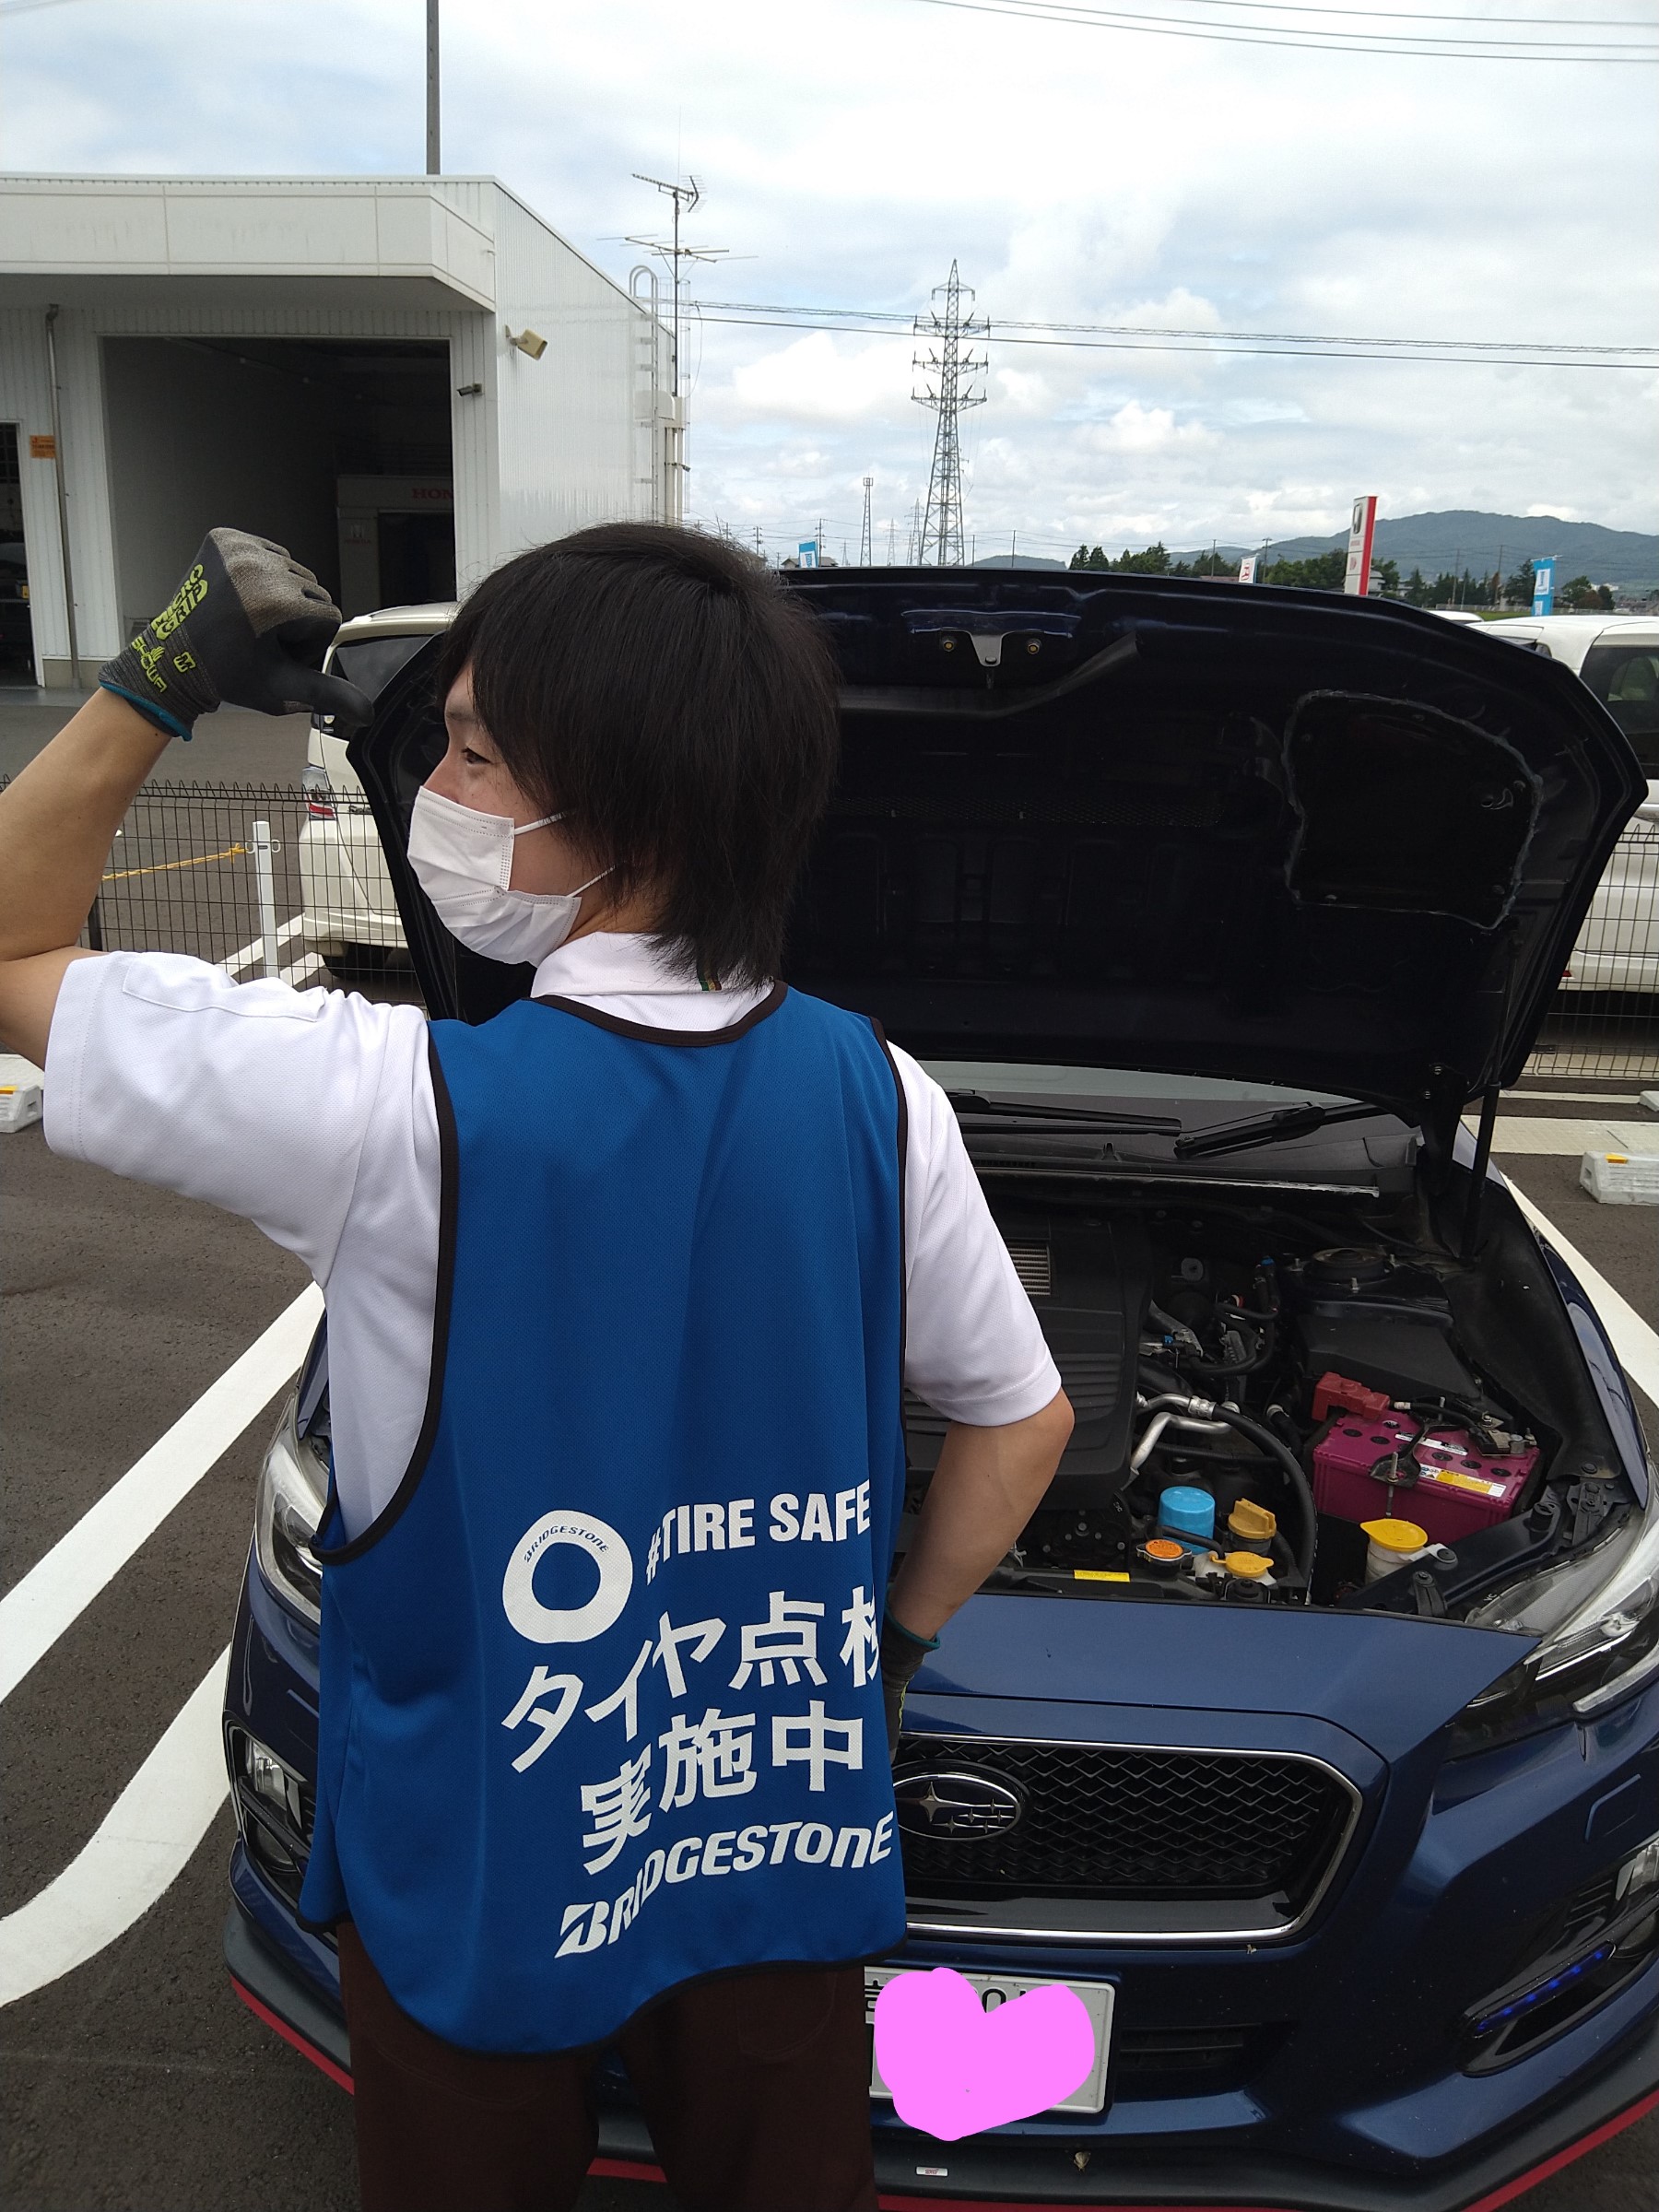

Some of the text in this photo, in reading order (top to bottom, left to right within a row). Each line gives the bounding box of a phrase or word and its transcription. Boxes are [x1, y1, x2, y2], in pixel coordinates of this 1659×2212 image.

[150, 564, 204, 630] MICRO
[157, 580, 207, 640] GRIP
[132, 636, 167, 692] SHOWA
[524, 1525, 609, 1563] BRIDGESTONE
[646, 1499, 755, 1585] #TIRE
[581, 1700, 863, 1875] 実施中
[555, 1811, 894, 1959] BRIDGESTONE
